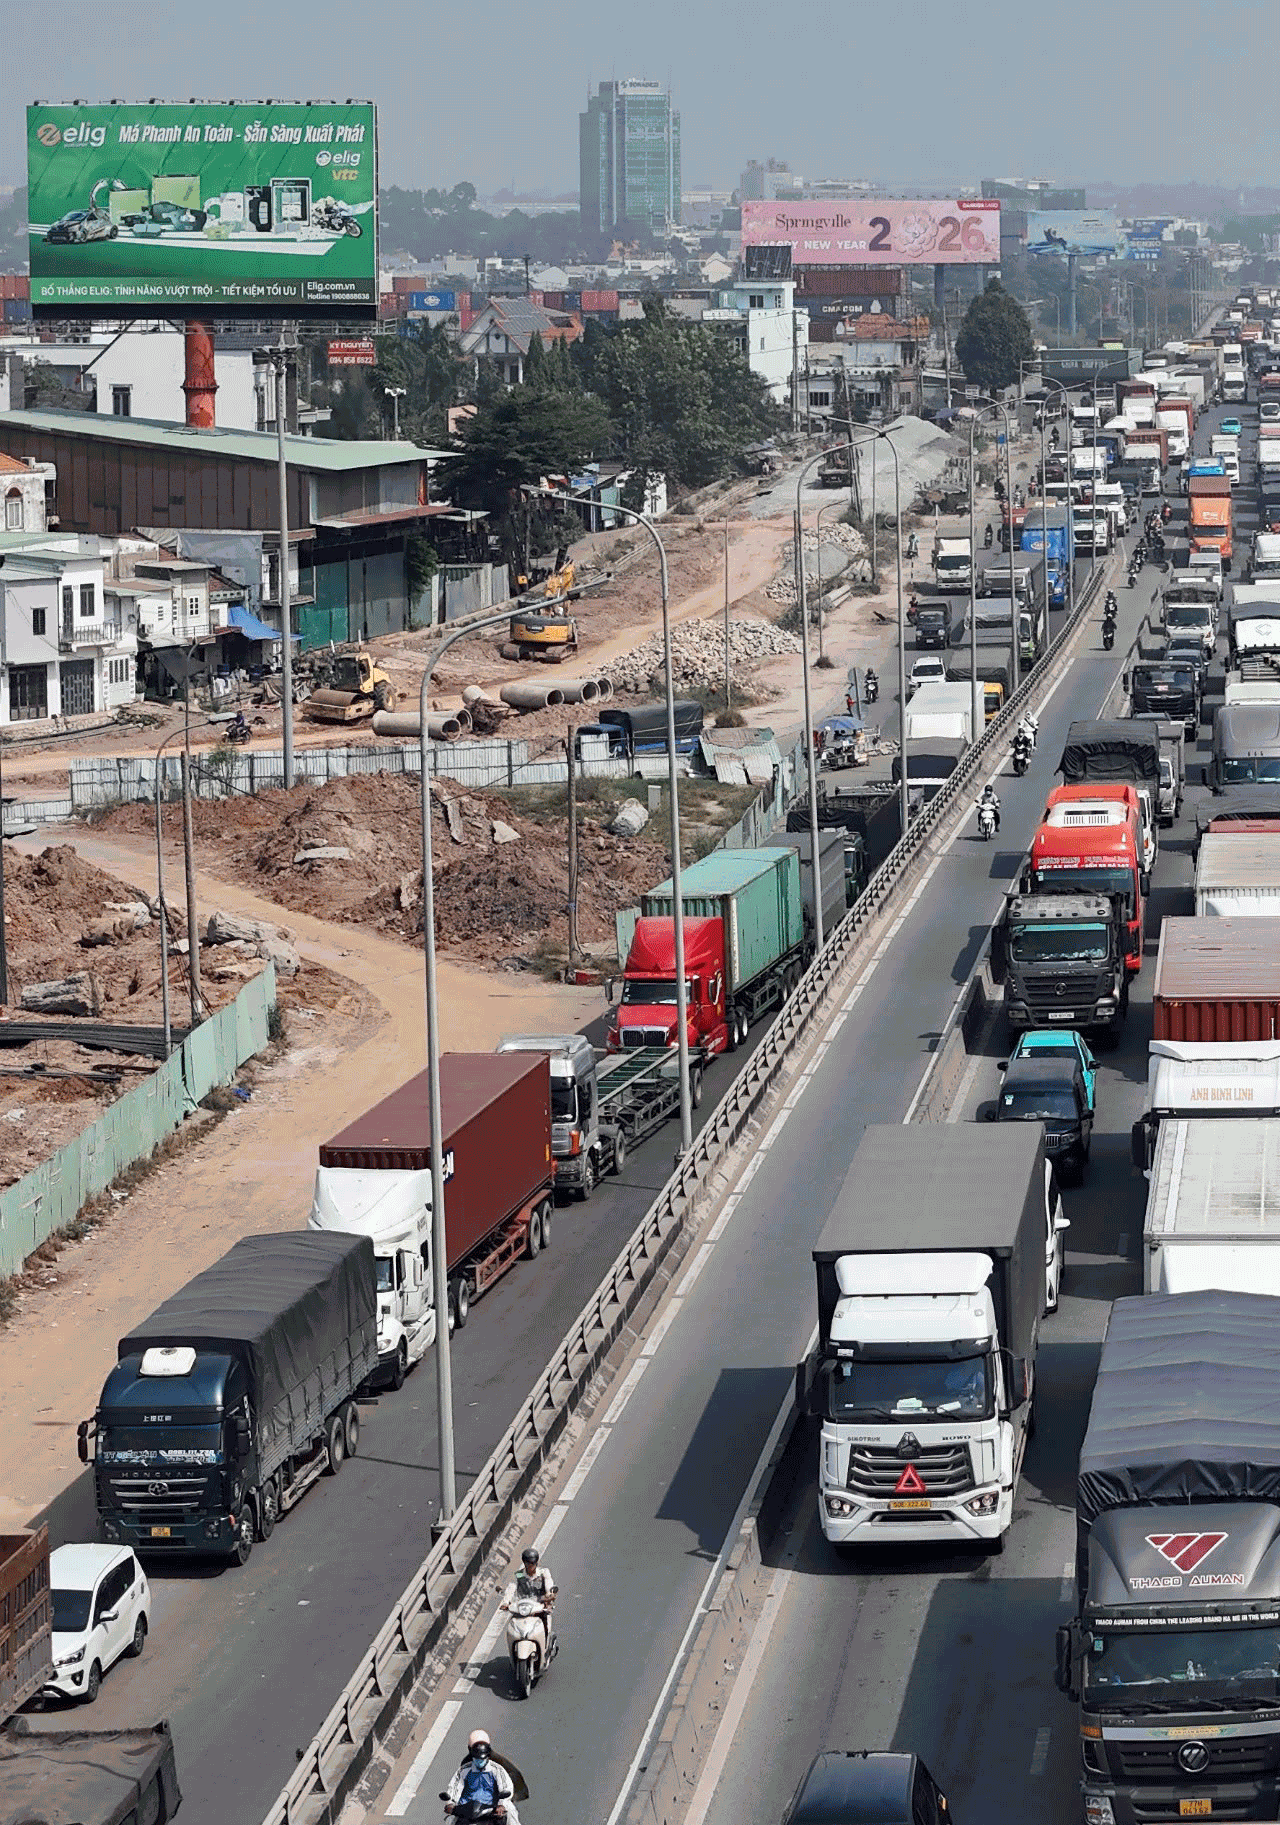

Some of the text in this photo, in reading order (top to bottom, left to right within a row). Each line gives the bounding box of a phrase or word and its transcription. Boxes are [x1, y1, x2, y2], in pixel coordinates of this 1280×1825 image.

[63, 121, 106, 147] elig
[118, 124, 140, 143] Má
[142, 125, 182, 143] Phanh
[184, 125, 201, 143] An
[203, 123, 234, 142] Toàn
[243, 120, 268, 142] Sẵn
[270, 123, 303, 145] Sàng
[303, 122, 334, 143] Xuất
[335, 123, 366, 143] Phát
[332, 150, 361, 167] elig
[775, 213, 851, 231] Springville
[804, 240, 831, 250] NEW
[837, 240, 867, 250] YEAR
[41, 284, 55, 296] BỐ
[90, 285, 113, 296] ELIG:
[114, 283, 137, 296] TÍNH
[137, 283, 165, 296] NĂNG
[165, 285, 190, 298] VƯỢT
[192, 283, 213, 298] TRỘI
[221, 282, 241, 296] TIẾT
[243, 283, 265, 298] KIỆM
[266, 282, 281, 296] TỐI
[283, 286, 297, 296] ƯU
[307, 281, 356, 292] Elig.com.vn
[307, 292, 331, 300] Hotline
[822, 305, 841, 313] CMA
[1190, 1087, 1209, 1101] ANH
[1130, 1574, 1245, 1589] THACO AUMAN
[1096, 1618, 1113, 1626] THACO
